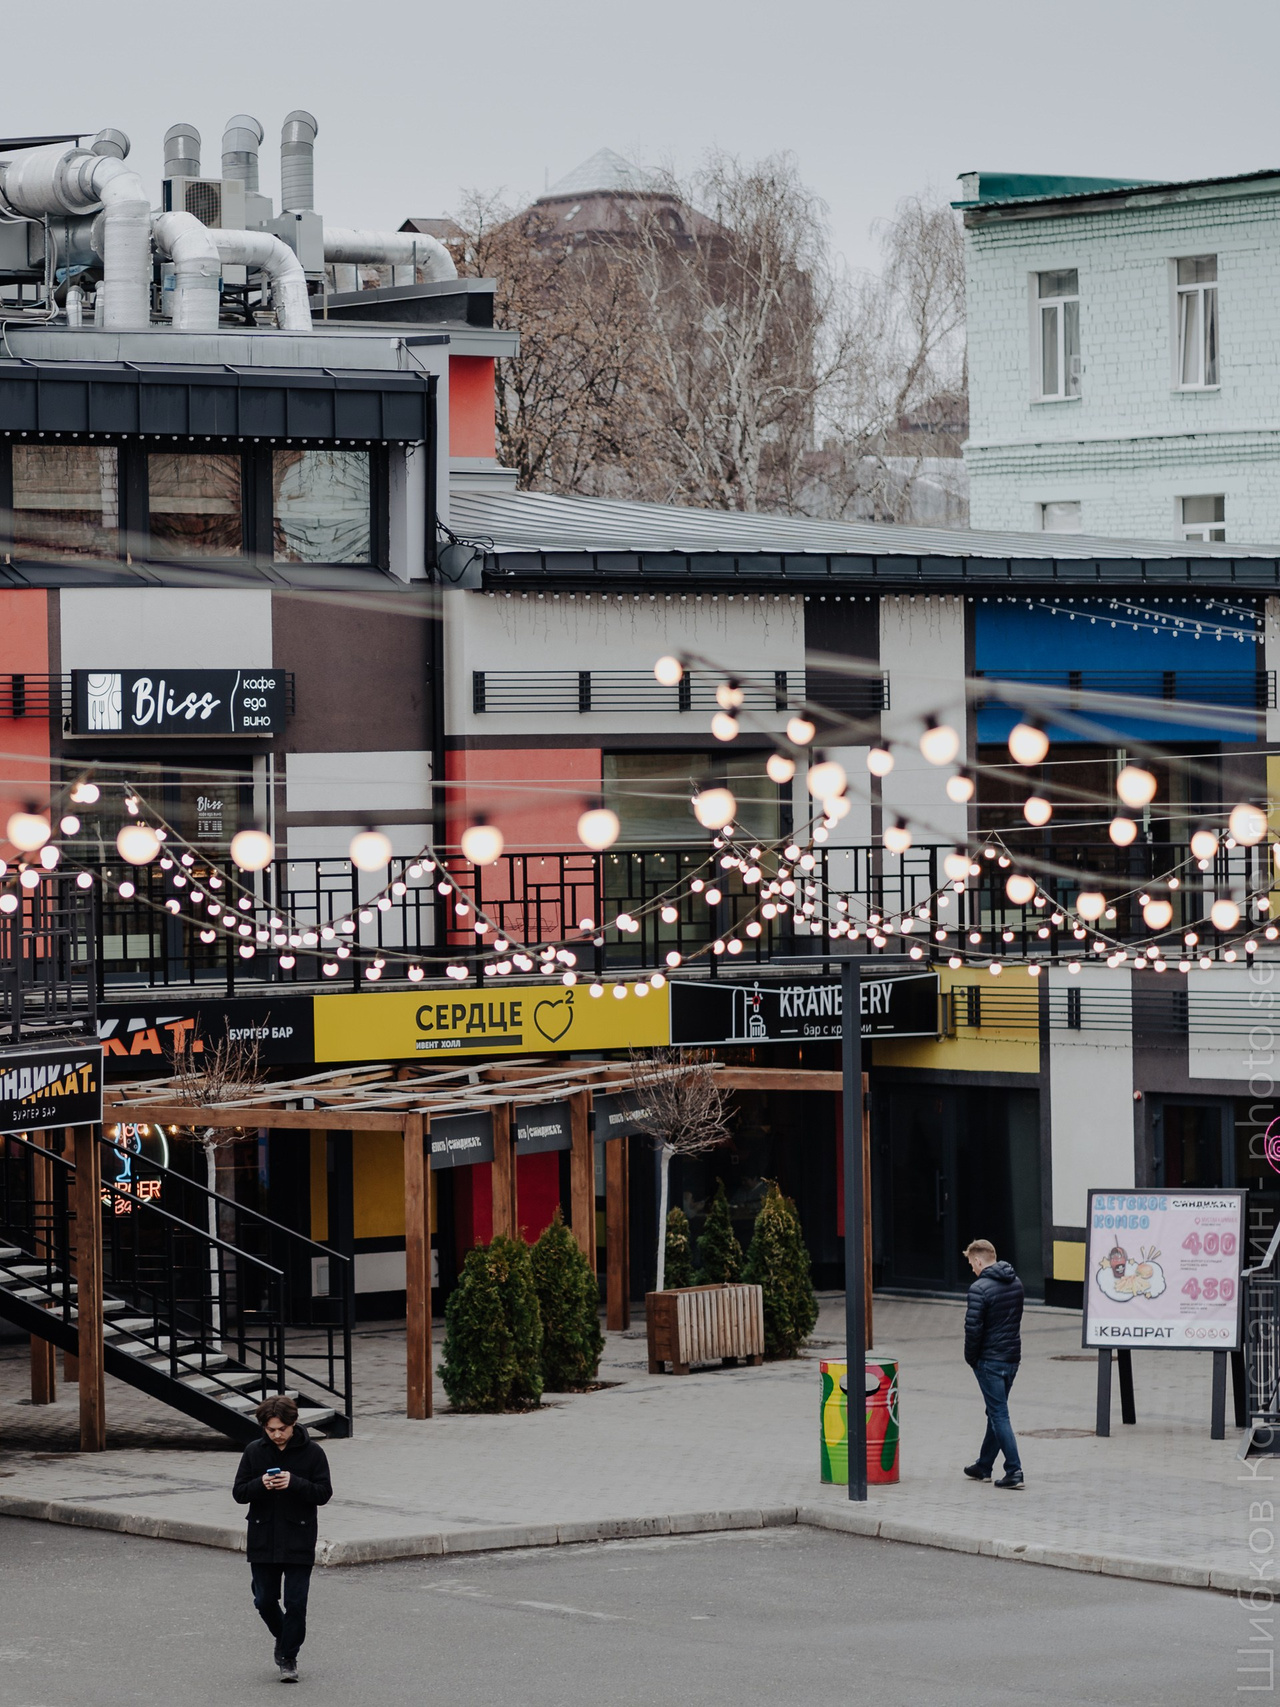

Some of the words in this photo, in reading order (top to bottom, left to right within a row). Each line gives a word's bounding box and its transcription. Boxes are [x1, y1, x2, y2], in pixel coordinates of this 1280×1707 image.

[243, 676, 276, 693] кафе
[131, 677, 221, 726] Bliss
[196, 796, 224, 812] Bliss
[415, 1001, 523, 1034] СЕРДЦЕ
[229, 1028, 270, 1041] БУРГЕР
[271, 1026, 294, 1039] БАР
[803, 1023, 821, 1037] бар
[416, 1040, 439, 1050] ИВЕНТ
[440, 1039, 461, 1049] ХОЛЛ
[12, 1109, 40, 1121] БУРГЕР
[42, 1106, 56, 1118] БАР
[1094, 1195, 1168, 1211] ДЕТСКОЕ
[1093, 1214, 1151, 1230] КОМБО
[1181, 1231, 1237, 1256] 400
[1099, 1326, 1175, 1338] КВАДРАТ
